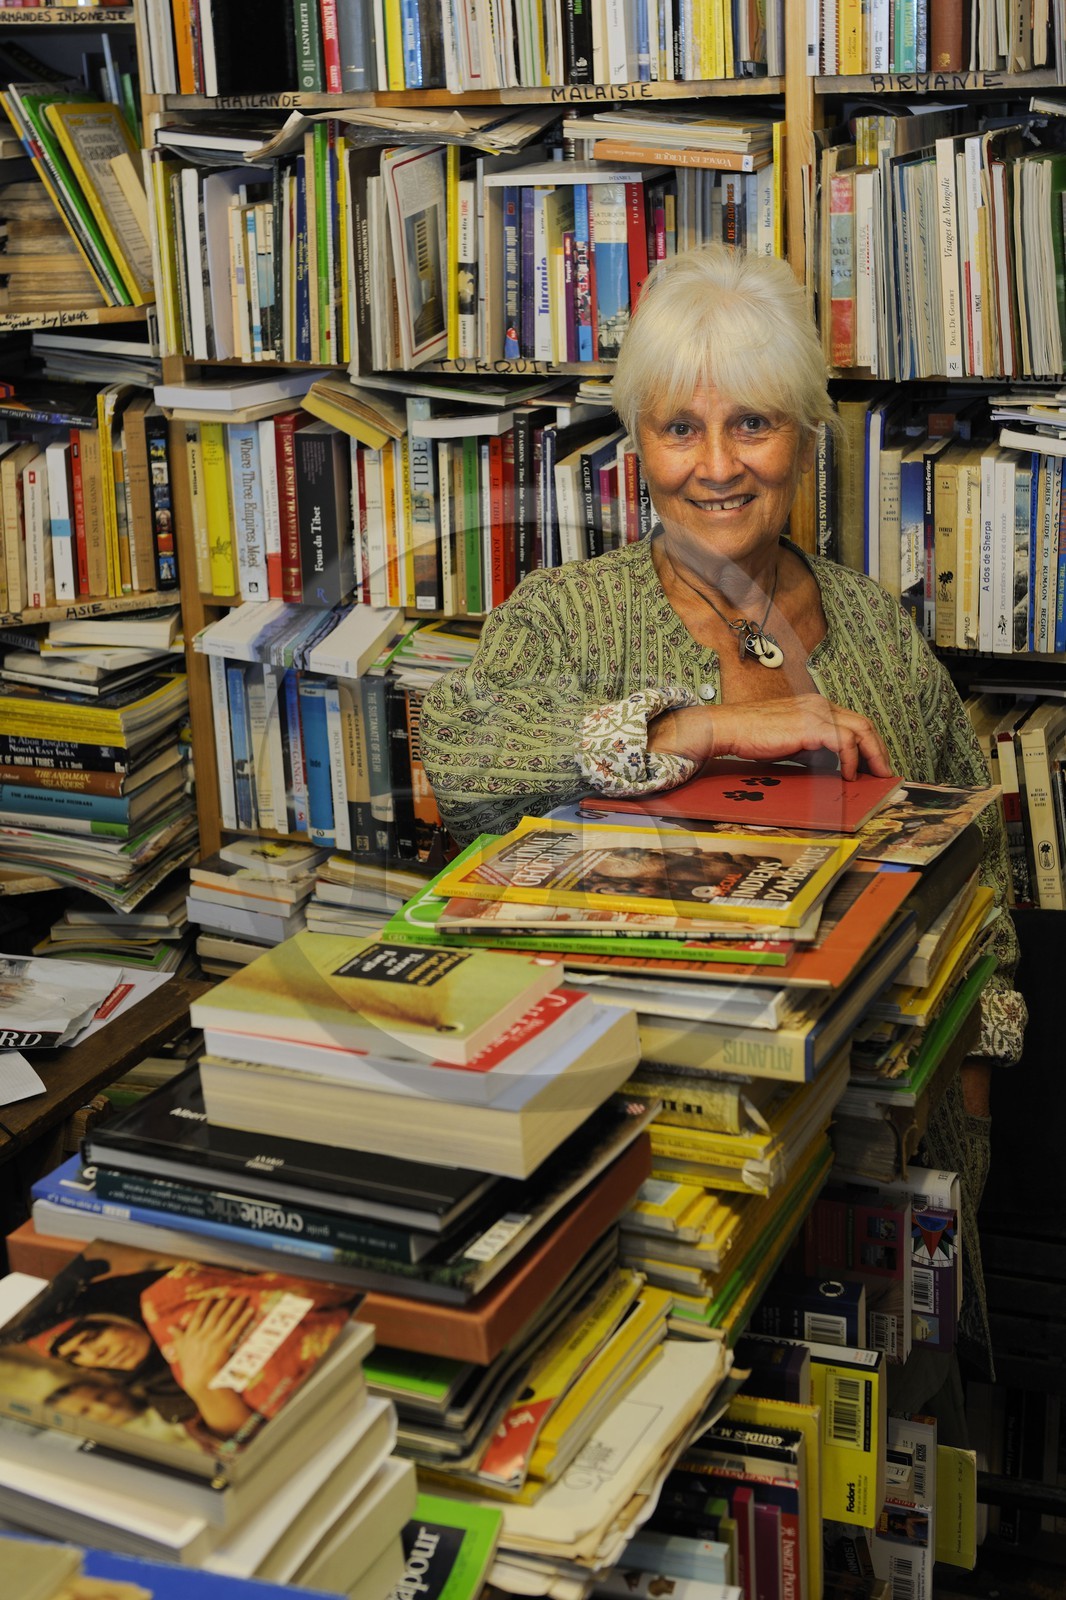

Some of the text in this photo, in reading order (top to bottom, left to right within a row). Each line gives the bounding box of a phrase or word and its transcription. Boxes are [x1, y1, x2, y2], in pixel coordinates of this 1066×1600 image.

[0, 11, 126, 21] RMANDES INDONESIE
[300, 3, 310, 55] ELEPHANTS
[323, 6, 336, 40] BANGKOK
[904, 2, 914, 47] MYANMAR
[874, 46, 883, 69] Bradt
[552, 84, 653, 102] MALAISIE
[870, 73, 1003, 93] BIRMANIE
[214, 95, 302, 109] THAILANDE
[703, 157, 732, 167] VOYAGE
[726, 184, 735, 239] DES AUTRES
[941, 177, 954, 258] Visages de Mongolie
[361, 219, 370, 270] MONUMENTS
[506, 226, 518, 316] guide routier de turquie
[578, 246, 589, 298] TURKEY
[537, 257, 550, 316] Turquie
[433, 358, 561, 374] TURQUIE
[402, 454, 408, 462] DU
[412, 435, 431, 524] LE TIBE
[492, 478, 499, 489] LE
[583, 467, 592, 490] GUIDE
[240, 437, 260, 568] Where Three Empires Meet
[283, 435, 297, 559] EARLY JESUIT TRAVELLERS
[585, 493, 592, 503] TO
[819, 471, 827, 519] HIMALAYAS
[91, 505, 98, 516] AU
[92, 535, 99, 547] DU
[310, 506, 324, 572] Fous du Tibet
[982, 521, 992, 551] Sherpa
[982, 554, 991, 564] de
[1043, 547, 1050, 558] TO
[982, 567, 991, 583] dos
[367, 692, 381, 772] THE SULTANATE OF DELHI
[35, 758, 54, 767] TRIBES
[294, 751, 303, 792] GANGES
[310, 758, 321, 769] Inde
[357, 769, 363, 777] OF
[35, 770, 91, 783] THE ANDAMAN
[731, 861, 783, 898] INDIENS
[763, 847, 830, 901] D'AMÉRIQUE
[0, 1030, 43, 1047] RD
[722, 1039, 793, 1073] ATLANTIS
[734, 1430, 783, 1445] GUIDES
[745, 1473, 773, 1484] INSIGHT
[846, 1482, 855, 1512] Fodor's
[389, 1526, 441, 1600] apour
[783, 1539, 794, 1571] INSIGHT
